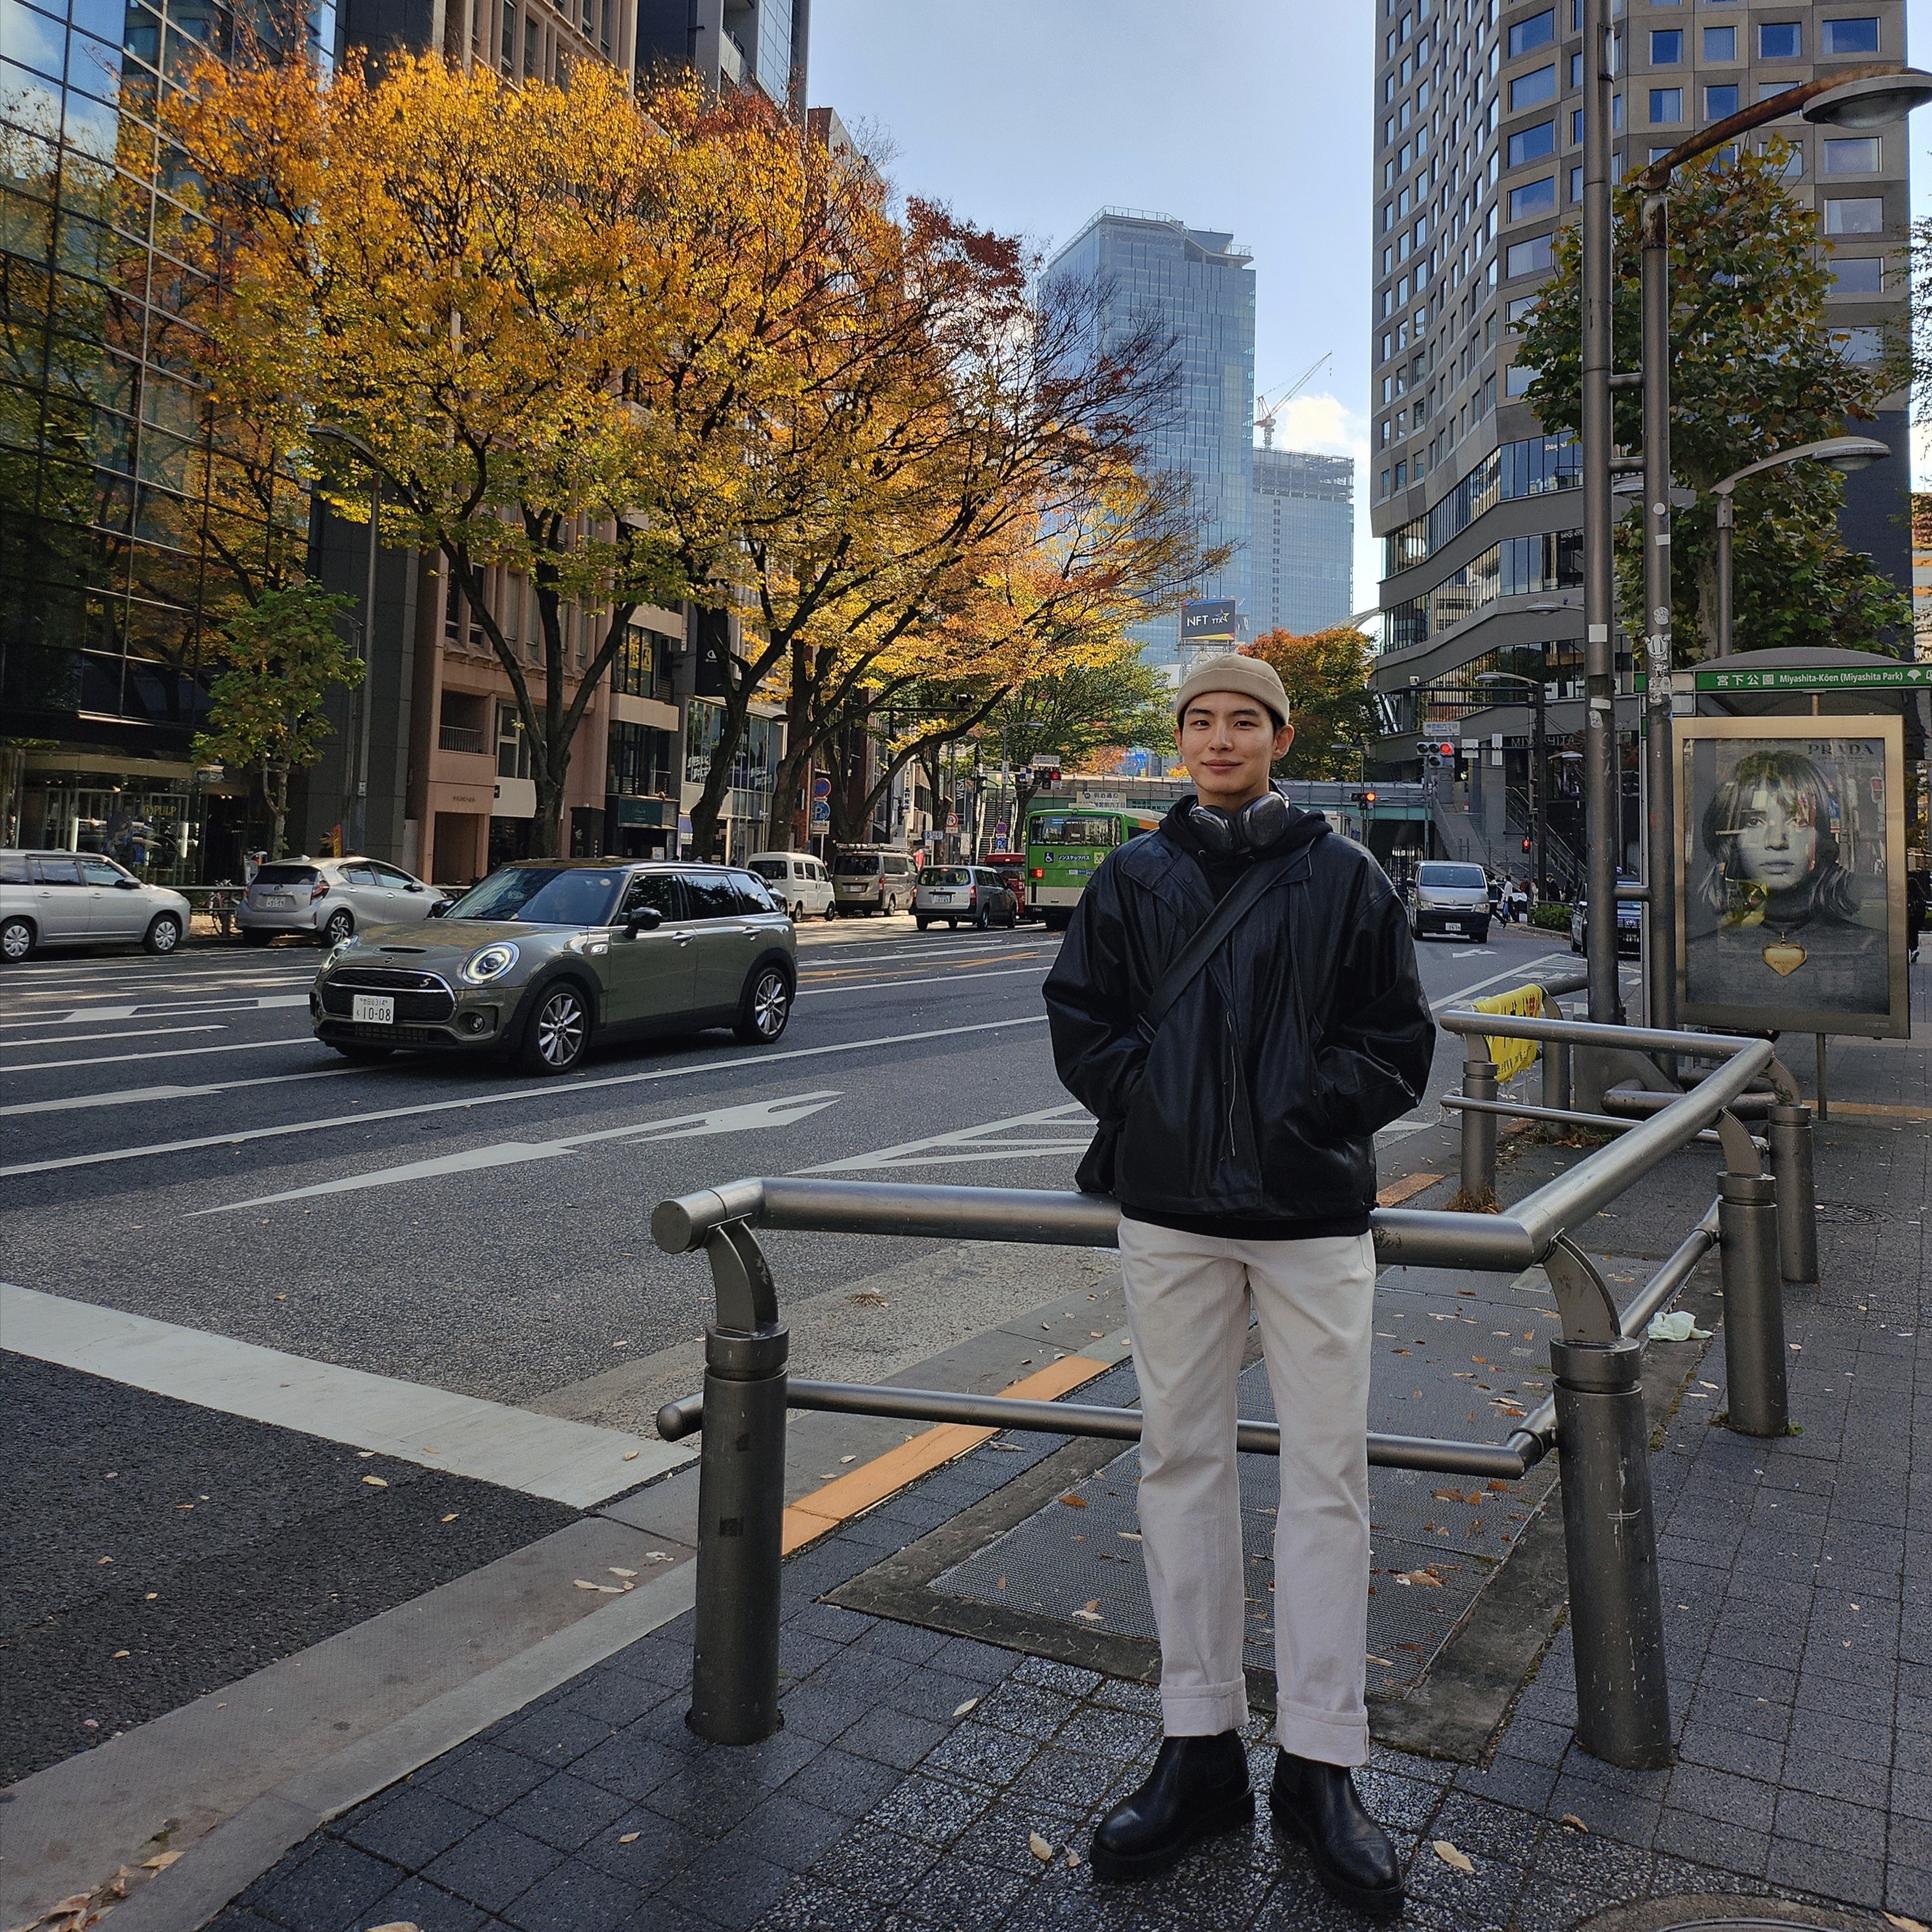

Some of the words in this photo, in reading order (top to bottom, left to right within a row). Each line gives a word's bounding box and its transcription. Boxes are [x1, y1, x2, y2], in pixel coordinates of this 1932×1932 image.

[1187, 615, 1209, 627] NFT
[1717, 675, 1774, 687] 宮下公園
[1779, 673, 1839, 684] Miyashita-Kōen
[1840, 672, 1881, 683] (Miyashita
[1882, 672, 1903, 681] Park)
[1511, 735, 1575, 747] MIYHITA
[1808, 744, 1873, 755] PRADA
[363, 1007, 391, 1021] 10-08
